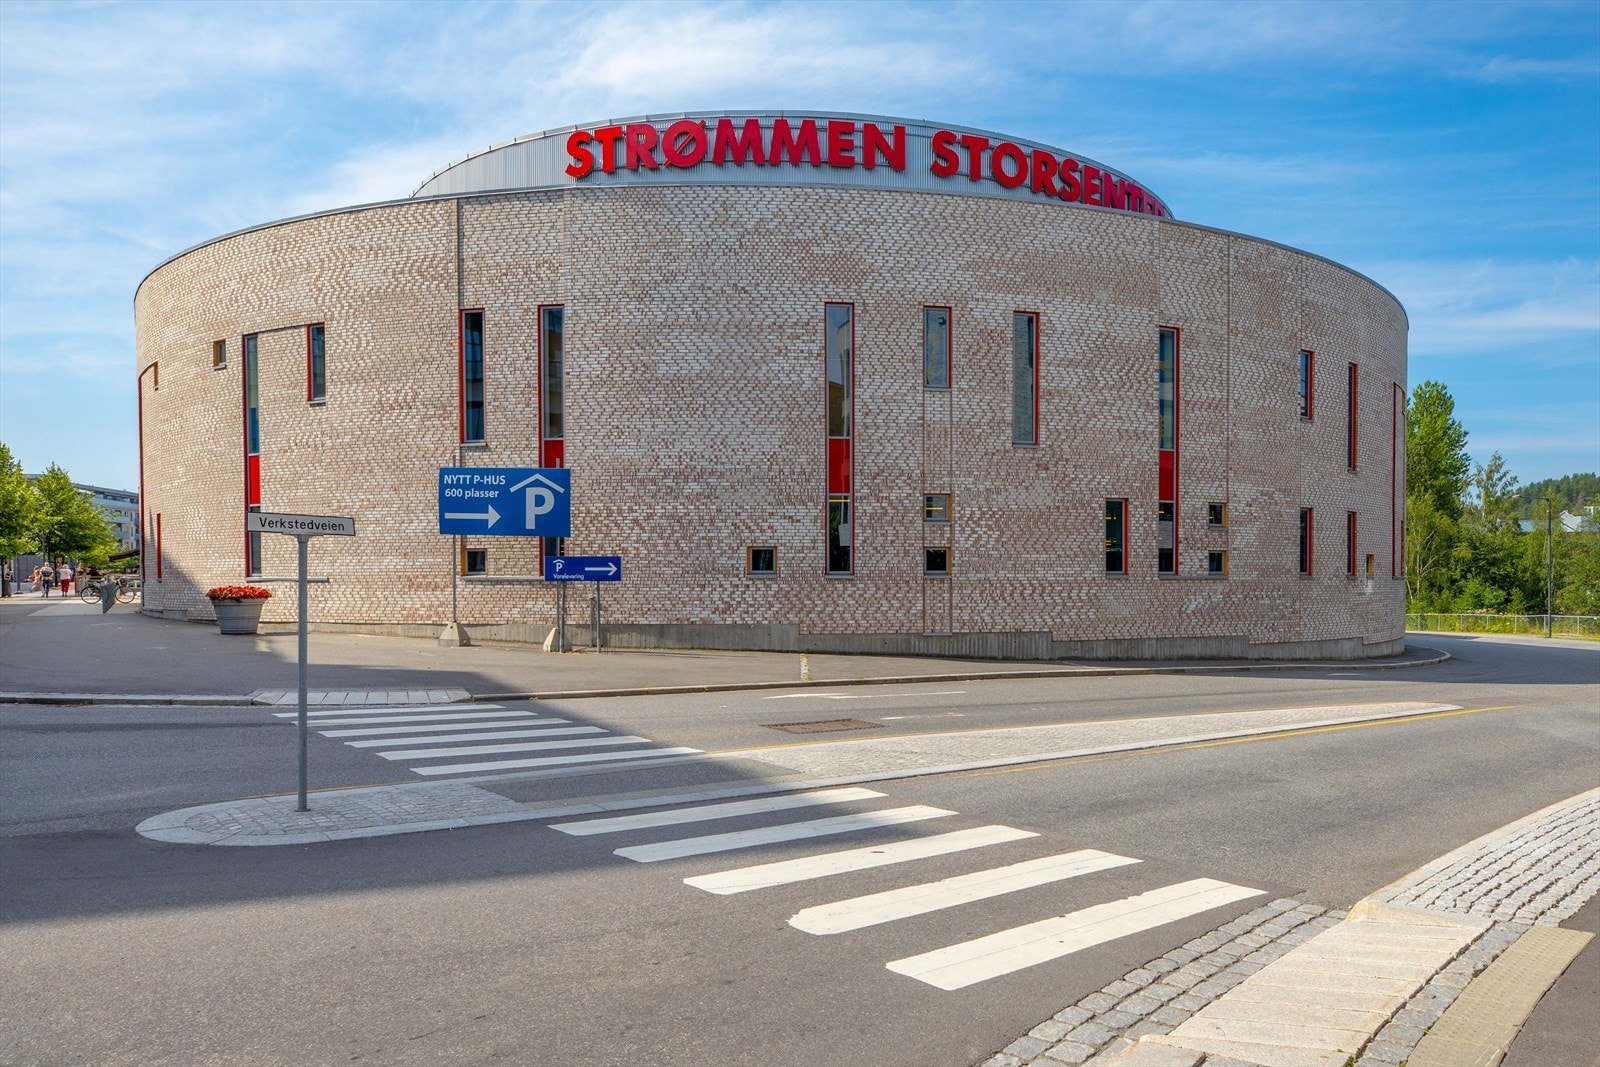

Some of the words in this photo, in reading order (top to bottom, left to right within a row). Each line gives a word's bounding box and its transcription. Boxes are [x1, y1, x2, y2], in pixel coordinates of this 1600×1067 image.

[565, 118, 905, 178] STRØMMEN
[444, 474, 471, 484] NYTT
[473, 475, 506, 485] P-HUS
[444, 488, 463, 498] 600
[464, 488, 500, 500] plasser
[525, 487, 555, 530] P
[259, 517, 345, 531] Verkstedveien
[556, 562, 563, 572] P
